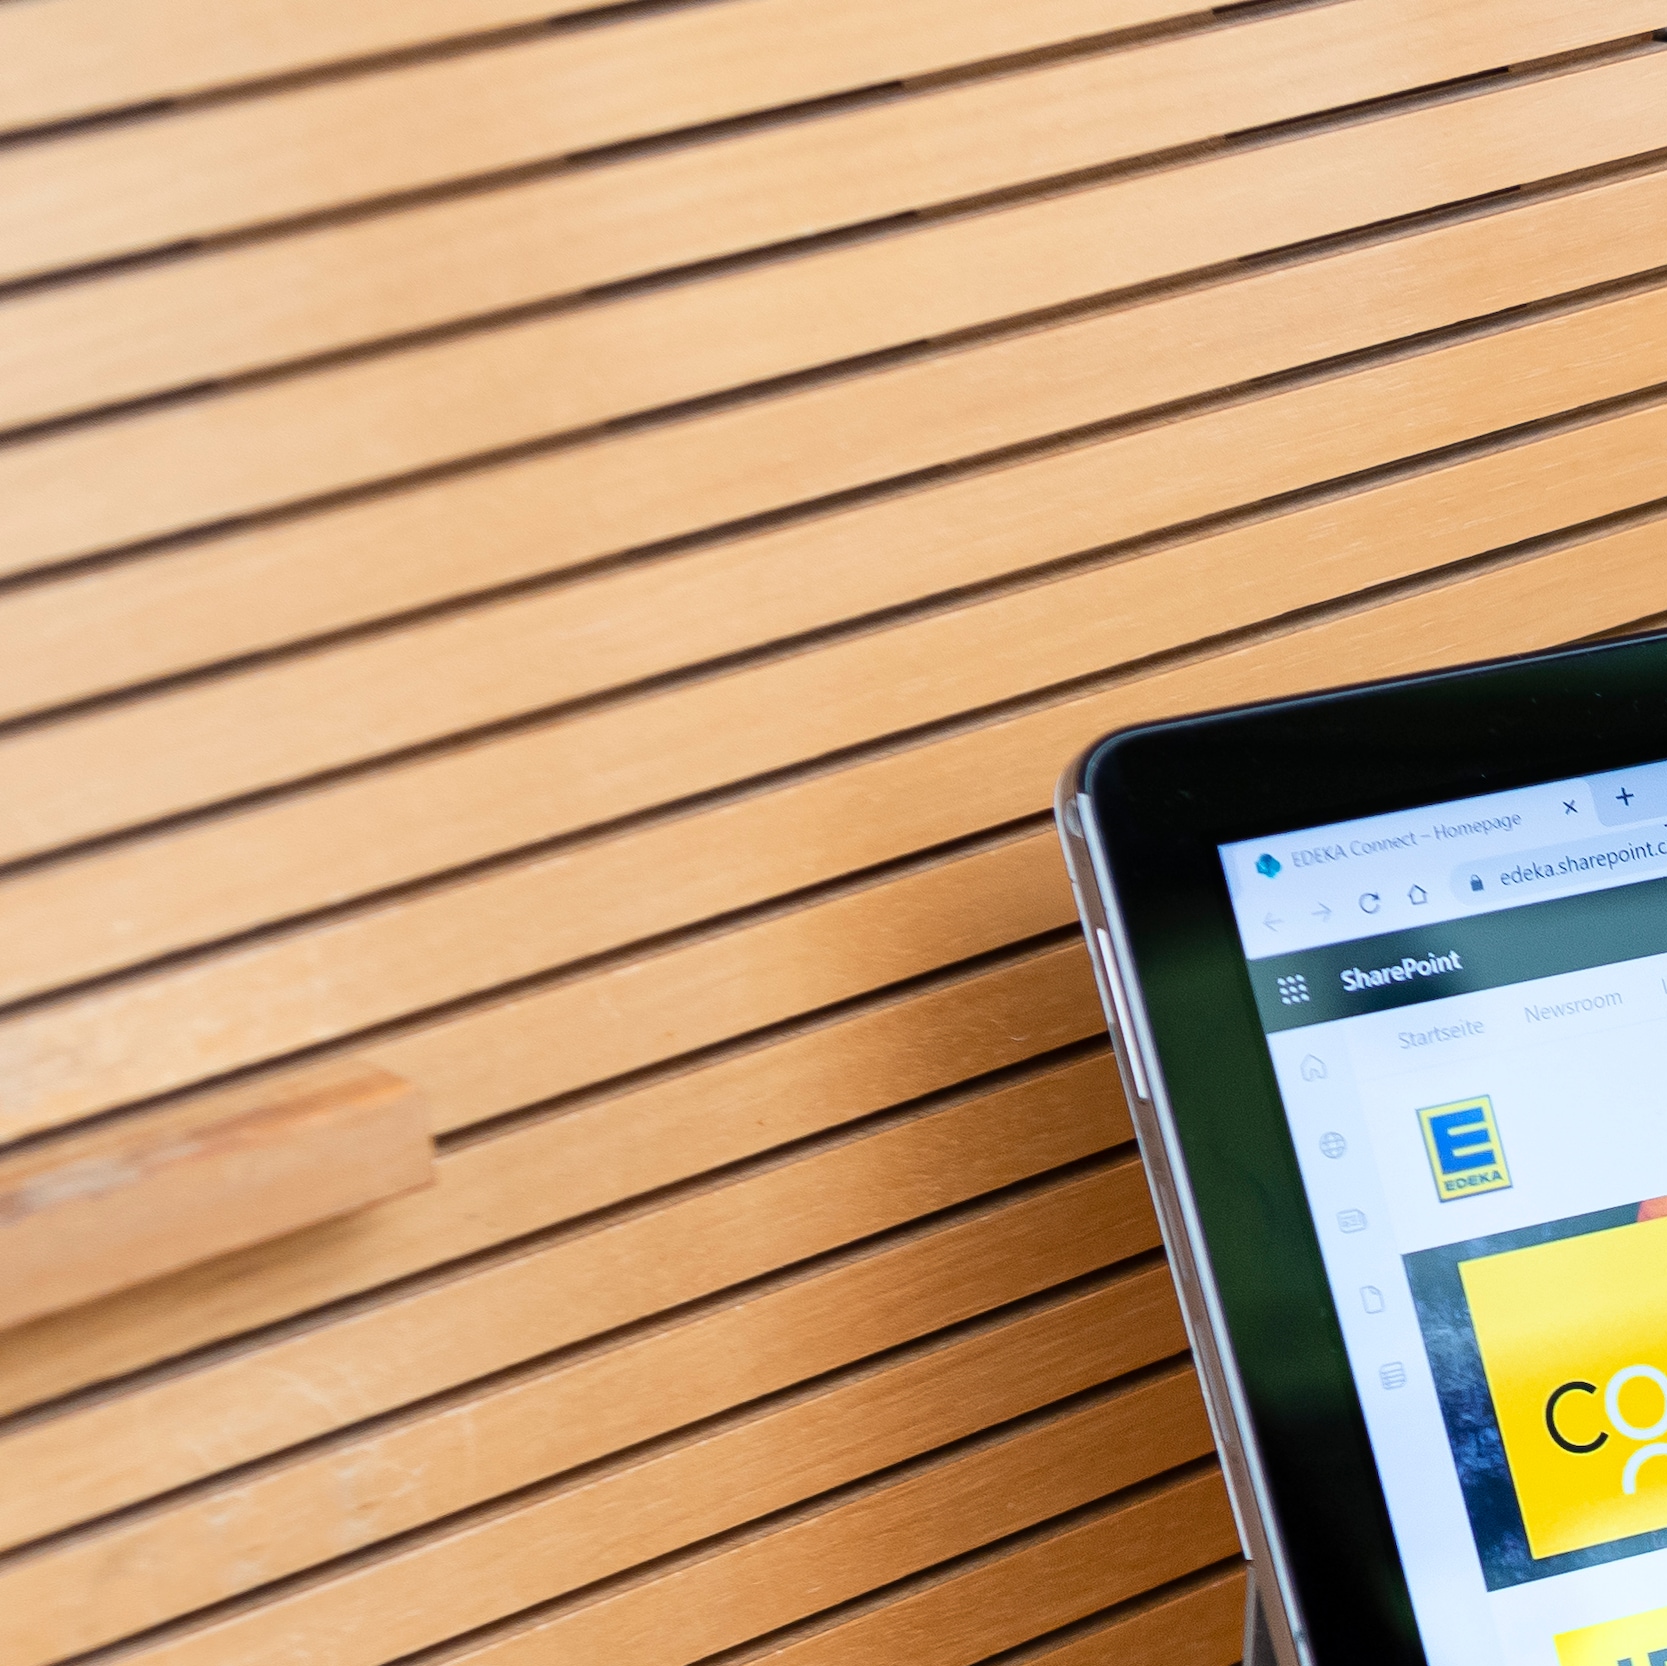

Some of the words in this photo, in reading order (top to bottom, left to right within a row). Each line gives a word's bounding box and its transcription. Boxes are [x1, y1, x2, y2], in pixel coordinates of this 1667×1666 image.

[1290, 842, 1347, 869] EDEKA
[1349, 831, 1418, 857] Connect
[1433, 810, 1522, 842] Homepage
[1340, 950, 1463, 993] SharePoint
[1523, 988, 1623, 1024] Newsroom
[1398, 1017, 1485, 1049] Startseite
[1443, 1169, 1504, 1193] EDEKA
